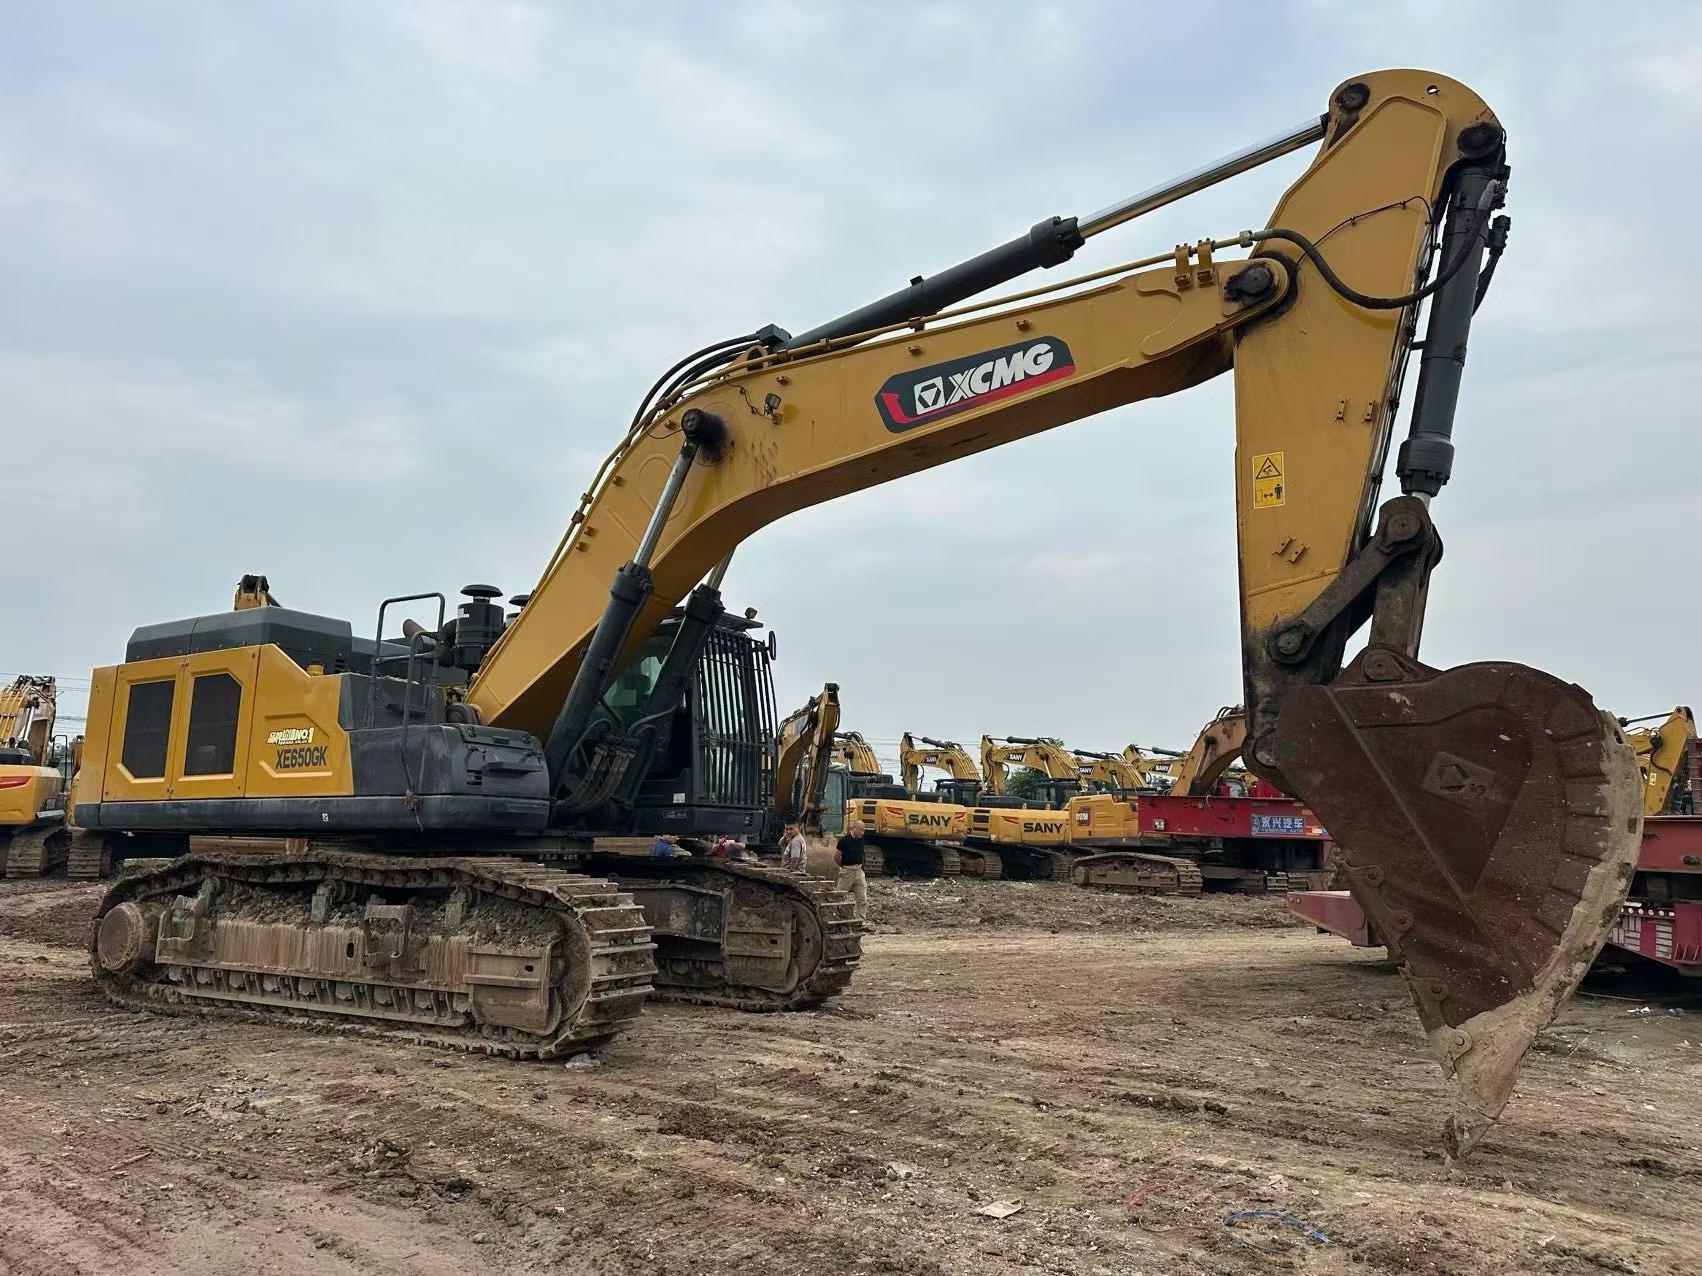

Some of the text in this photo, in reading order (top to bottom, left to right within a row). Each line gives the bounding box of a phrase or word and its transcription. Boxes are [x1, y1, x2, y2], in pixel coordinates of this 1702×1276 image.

[946, 343, 1054, 405] XCMG
[275, 746, 328, 769] XE650GK
[908, 814, 952, 827] SANY
[1261, 816, 1304, 829] 永兴汽车
[1023, 822, 1064, 834] SANY
